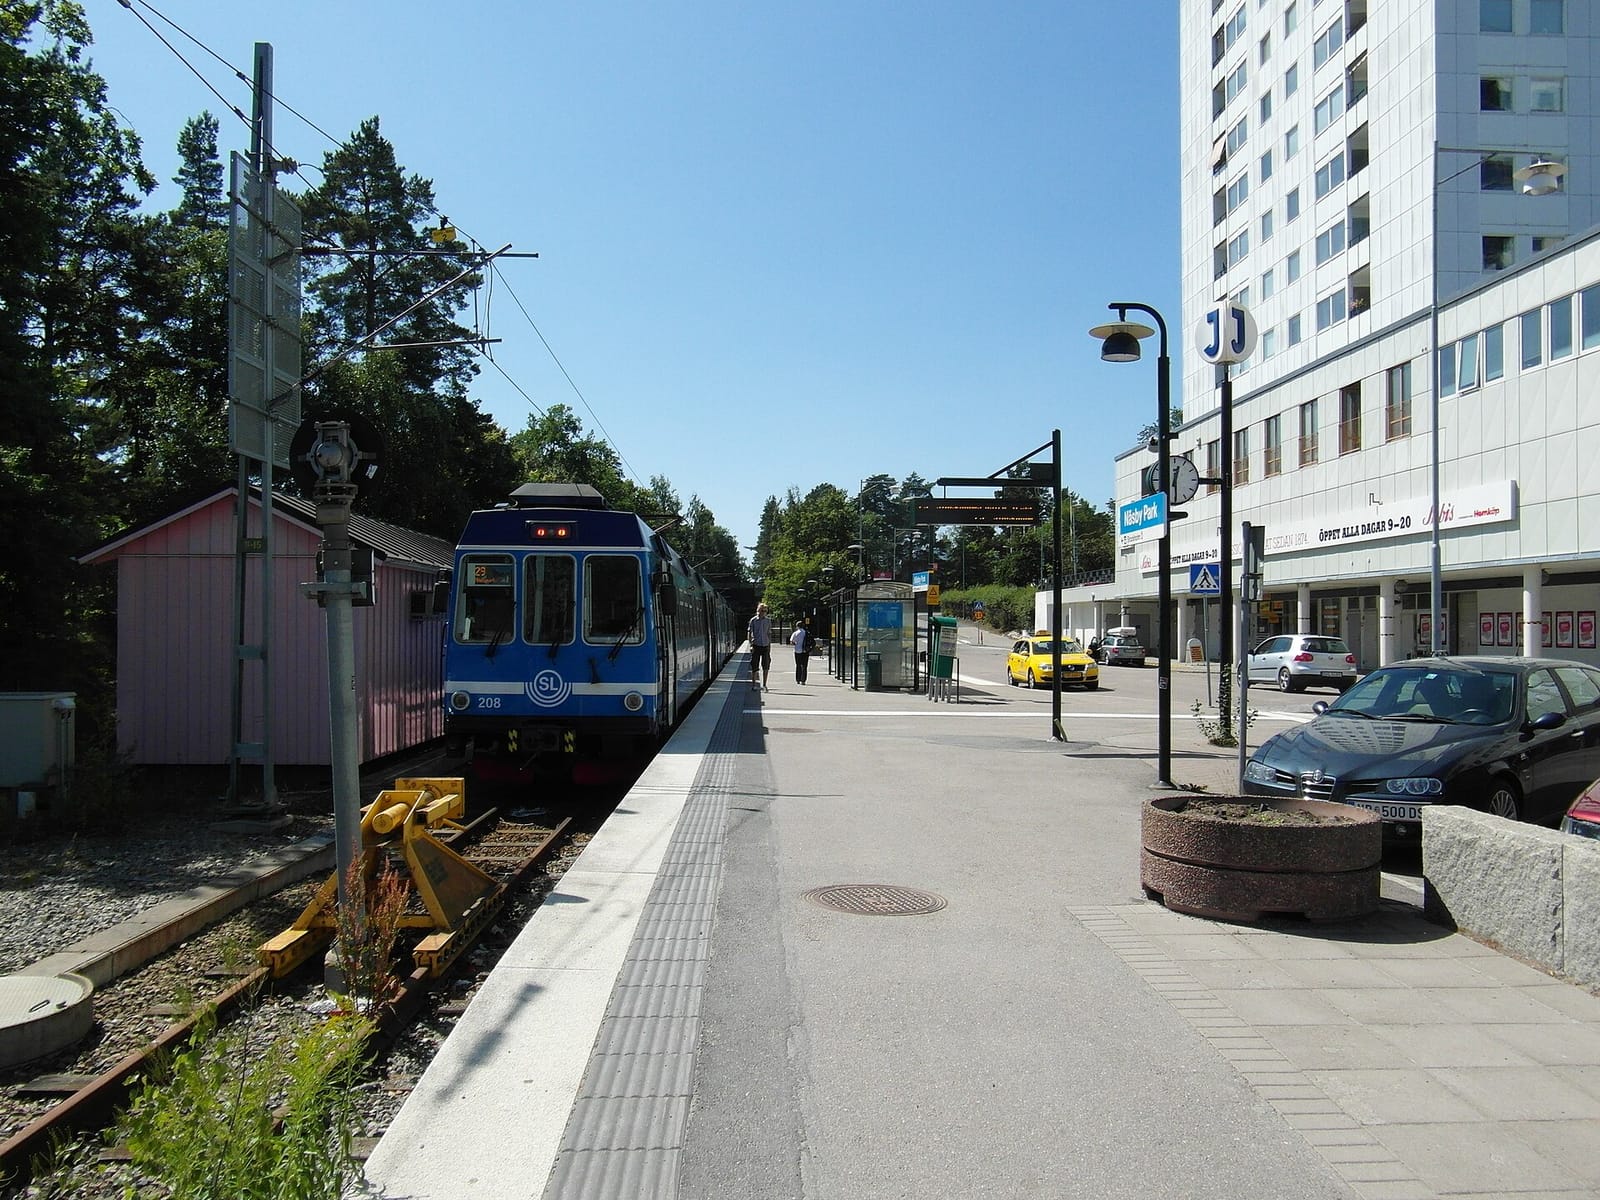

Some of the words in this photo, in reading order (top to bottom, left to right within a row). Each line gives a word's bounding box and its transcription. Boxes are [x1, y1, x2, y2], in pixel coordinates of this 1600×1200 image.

[1204, 308, 1219, 357] J
[1231, 307, 1245, 354] J
[1123, 508, 1143, 527] Näsby
[1143, 502, 1158, 522] Park
[1319, 528, 1341, 542] ÖPPET
[1342, 525, 1360, 538] ALLA
[1361, 520, 1386, 535] DAGAR
[539, 676, 558, 691] SL
[478, 697, 502, 709] 208
[1382, 806, 1406, 818] 500
